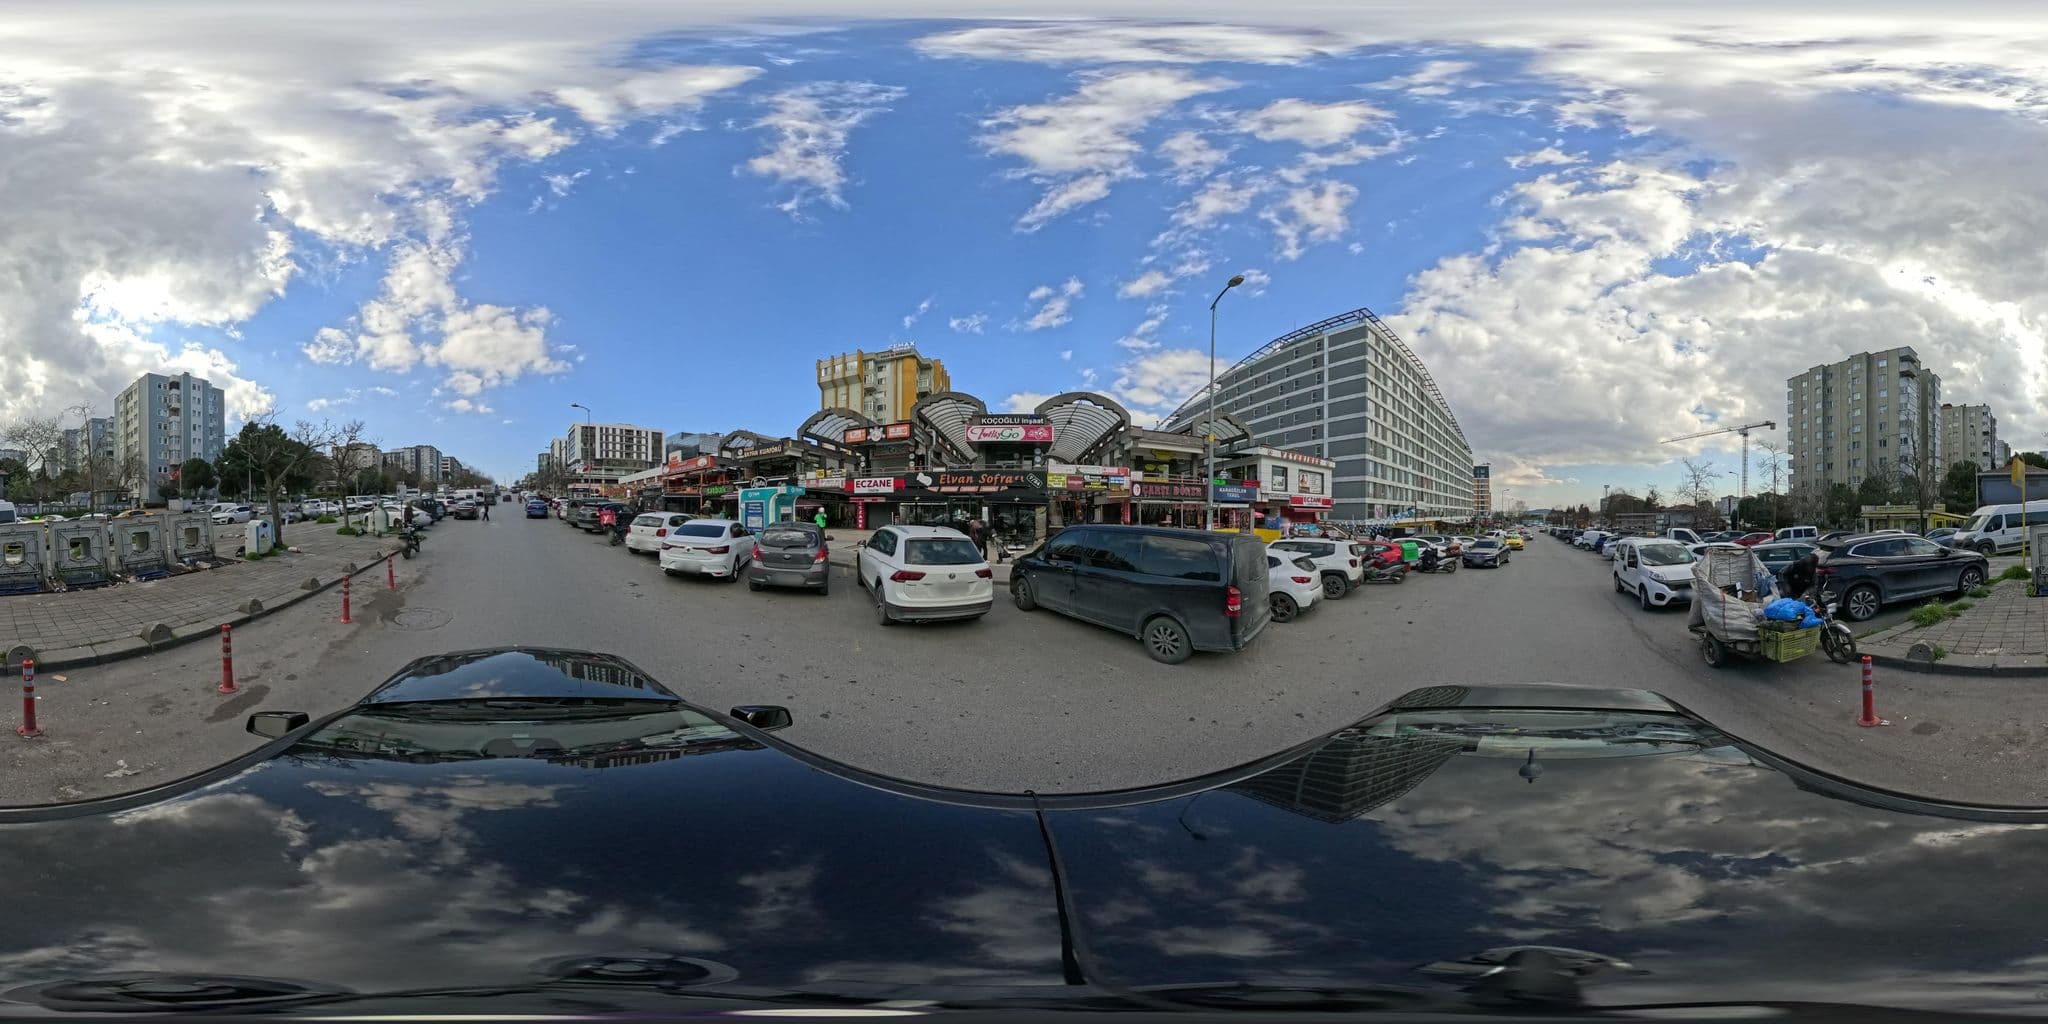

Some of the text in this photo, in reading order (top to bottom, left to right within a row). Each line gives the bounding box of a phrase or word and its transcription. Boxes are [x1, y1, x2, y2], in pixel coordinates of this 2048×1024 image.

[981, 416, 1020, 425] KOÇOĞLU
[855, 479, 892, 488] ECZANE
[939, 473, 974, 485] Elvan
